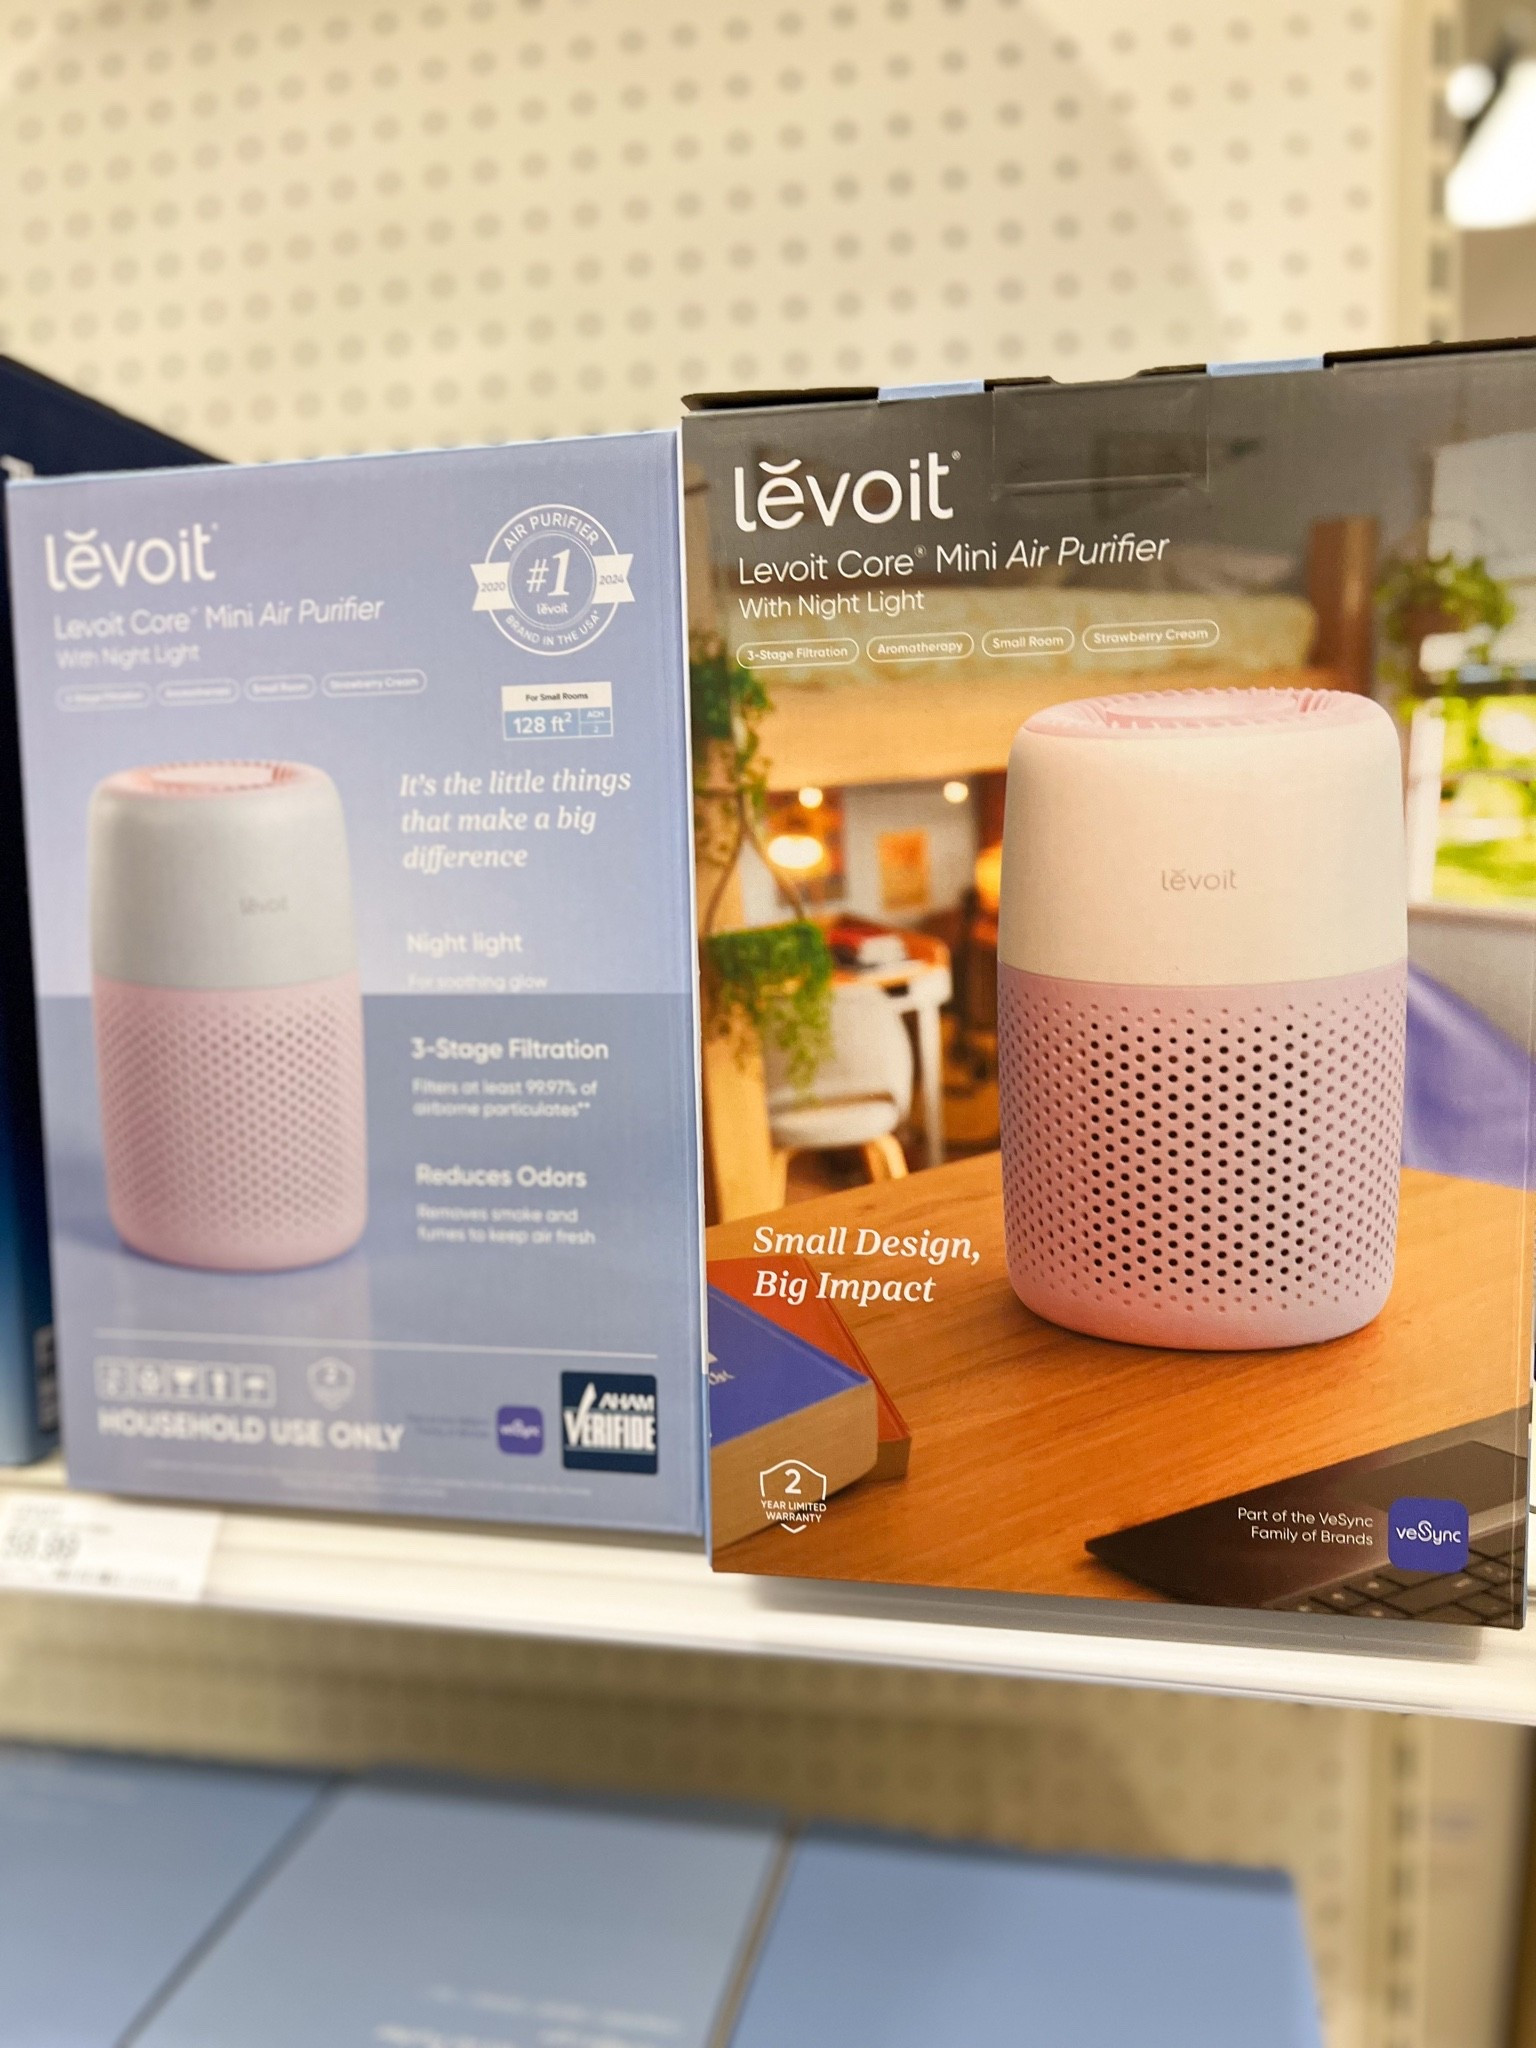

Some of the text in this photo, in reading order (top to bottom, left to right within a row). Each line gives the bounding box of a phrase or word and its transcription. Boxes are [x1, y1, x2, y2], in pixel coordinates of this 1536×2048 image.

[503, 512, 599, 551] AIR PURIFIER
[738, 553, 829, 585] Levoit
[936, 541, 998, 574] Mini
[1004, 538, 1050, 570] Air
[1057, 532, 1171, 567] Purifier
[526, 549, 570, 596] #1
[598, 574, 625, 586] 2024
[480, 581, 506, 593] 2020
[54, 613, 126, 641] Levoit
[205, 604, 253, 630] Mini
[259, 601, 293, 627] Air
[299, 595, 385, 625] Purifier
[738, 589, 925, 621] With Night Light
[505, 614, 540, 645] BRAND
[542, 635, 554, 646] IN
[558, 630, 579, 645] THE
[992, 634, 1064, 649] Small Room
[1093, 628, 1209, 646] Strawberry Cream
[103, 644, 150, 671] Night
[153, 642, 200, 667] Light
[747, 645, 848, 662] 3-Stage Filtration
[877, 640, 963, 656] Aromatherapy
[525, 692, 589, 701] For Small Rooms
[513, 716, 546, 734] 128
[443, 771, 482, 796] the
[489, 769, 545, 794] little
[552, 768, 632, 797] things
[401, 805, 597, 835] that make a big
[402, 844, 528, 874] difference
[406, 931, 523, 959] Night light
[508, 973, 548, 992] glow
[410, 1036, 609, 1065] 3-Stage Filtration
[580, 1079, 598, 1096] of
[415, 1162, 588, 1189] Reduces Odors
[545, 1208, 578, 1223] and
[555, 1228, 596, 1245] fresh
[752, 1225, 981, 1266] Small Design,
[752, 1269, 937, 1308] Big Impact
[97, 1406, 267, 1444] HOUSEHOLD
[269, 1416, 325, 1448] USE
[327, 1419, 404, 1452] ONLY
[563, 1384, 656, 1451] VERIFIDE
[784, 1468, 802, 1494] 2
[761, 1499, 827, 1512] YEAR LIMITED
[765, 1511, 822, 1523] WARRANTY
[1238, 1507, 1374, 1529] Part of the VeSync
[1251, 1525, 1374, 1546] Family of Brands
[1395, 1519, 1462, 1546] veSync
